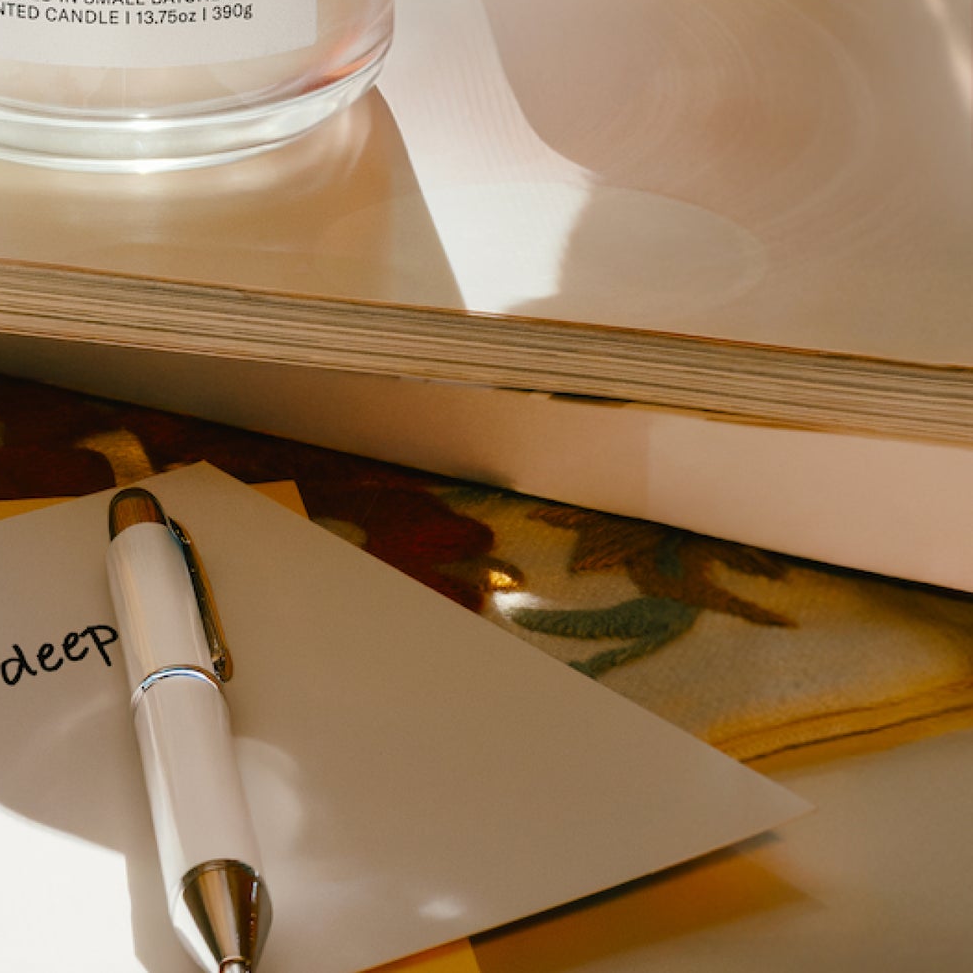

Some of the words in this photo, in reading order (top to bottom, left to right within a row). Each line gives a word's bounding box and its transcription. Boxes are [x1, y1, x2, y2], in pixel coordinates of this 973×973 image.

[45, 6, 119, 25] CANDLE
[137, 10, 197, 25] 13.75oz
[212, 3, 253, 20] 390g
[0, 623, 119, 686] deep
